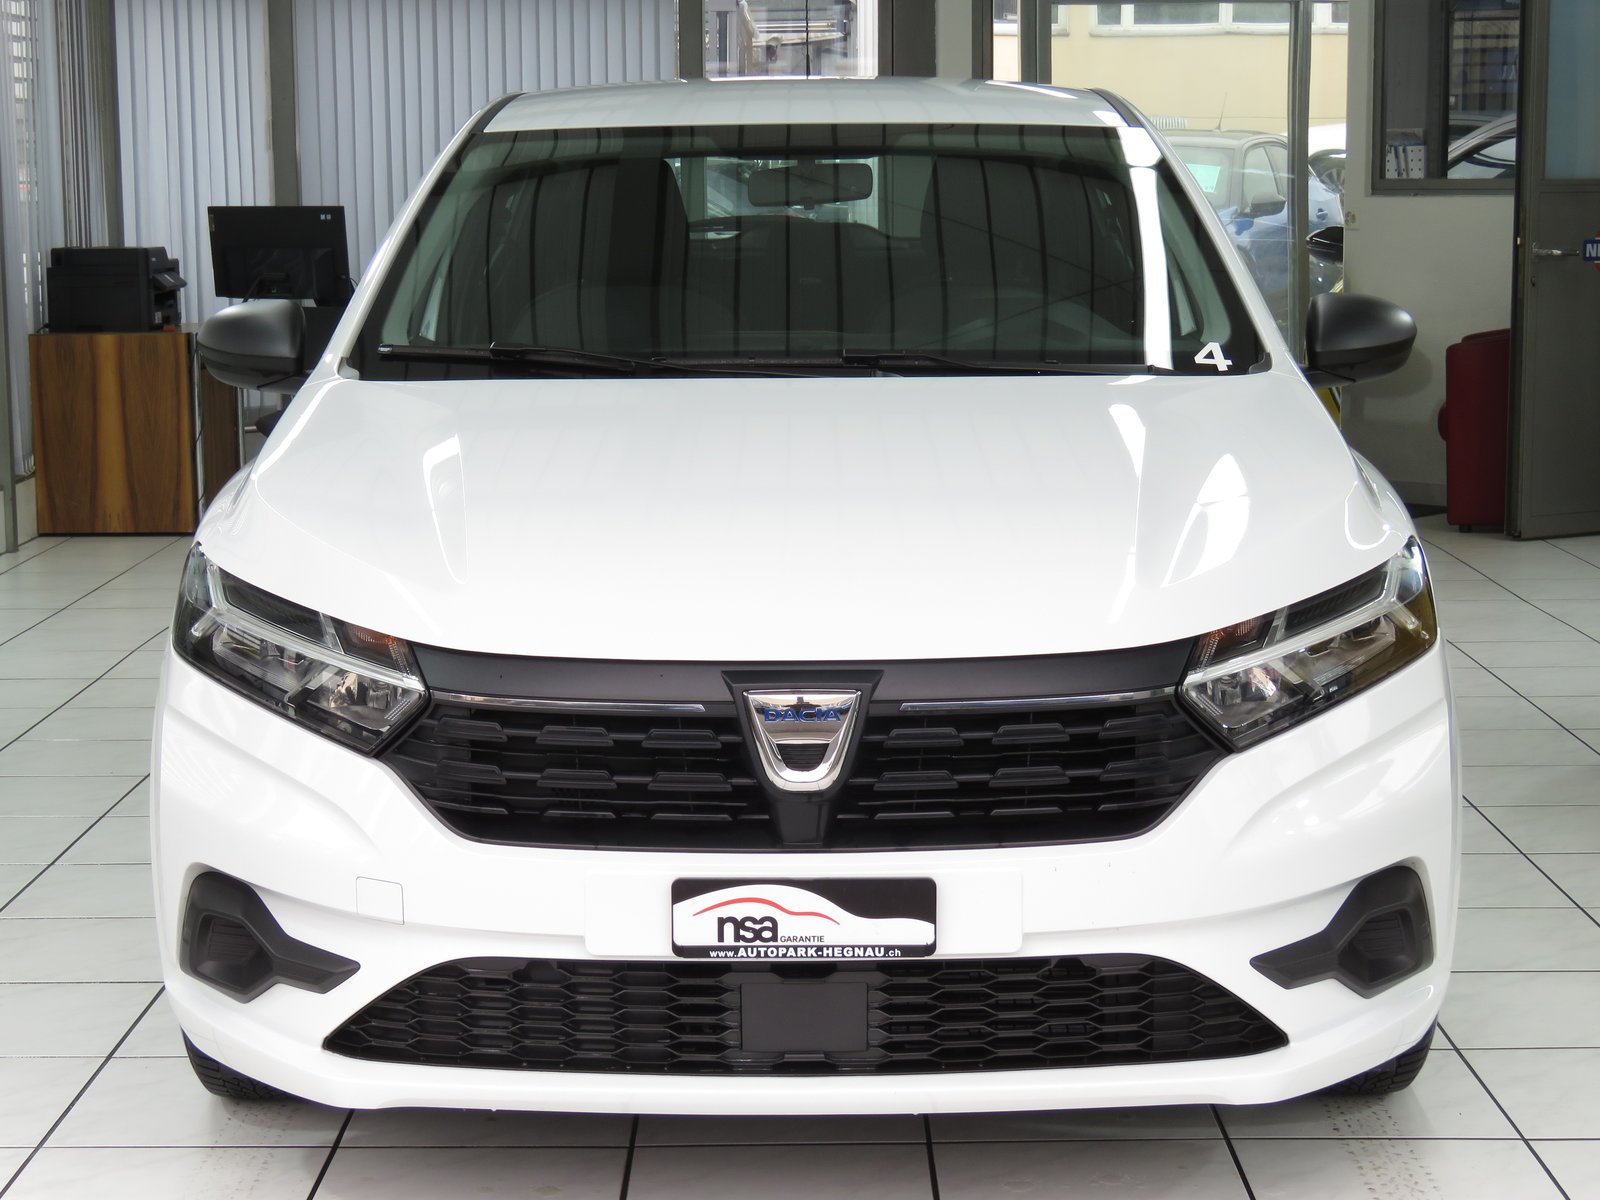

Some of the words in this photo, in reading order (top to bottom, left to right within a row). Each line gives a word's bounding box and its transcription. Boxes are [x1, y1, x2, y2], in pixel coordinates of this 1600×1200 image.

[1194, 342, 1232, 371] 4
[764, 708, 841, 723] DACIA
[717, 916, 778, 943] nsa
[780, 935, 825, 943] GARANTIE
[709, 947, 901, 958] www.AUTOPARK-HEGNAU.ch
